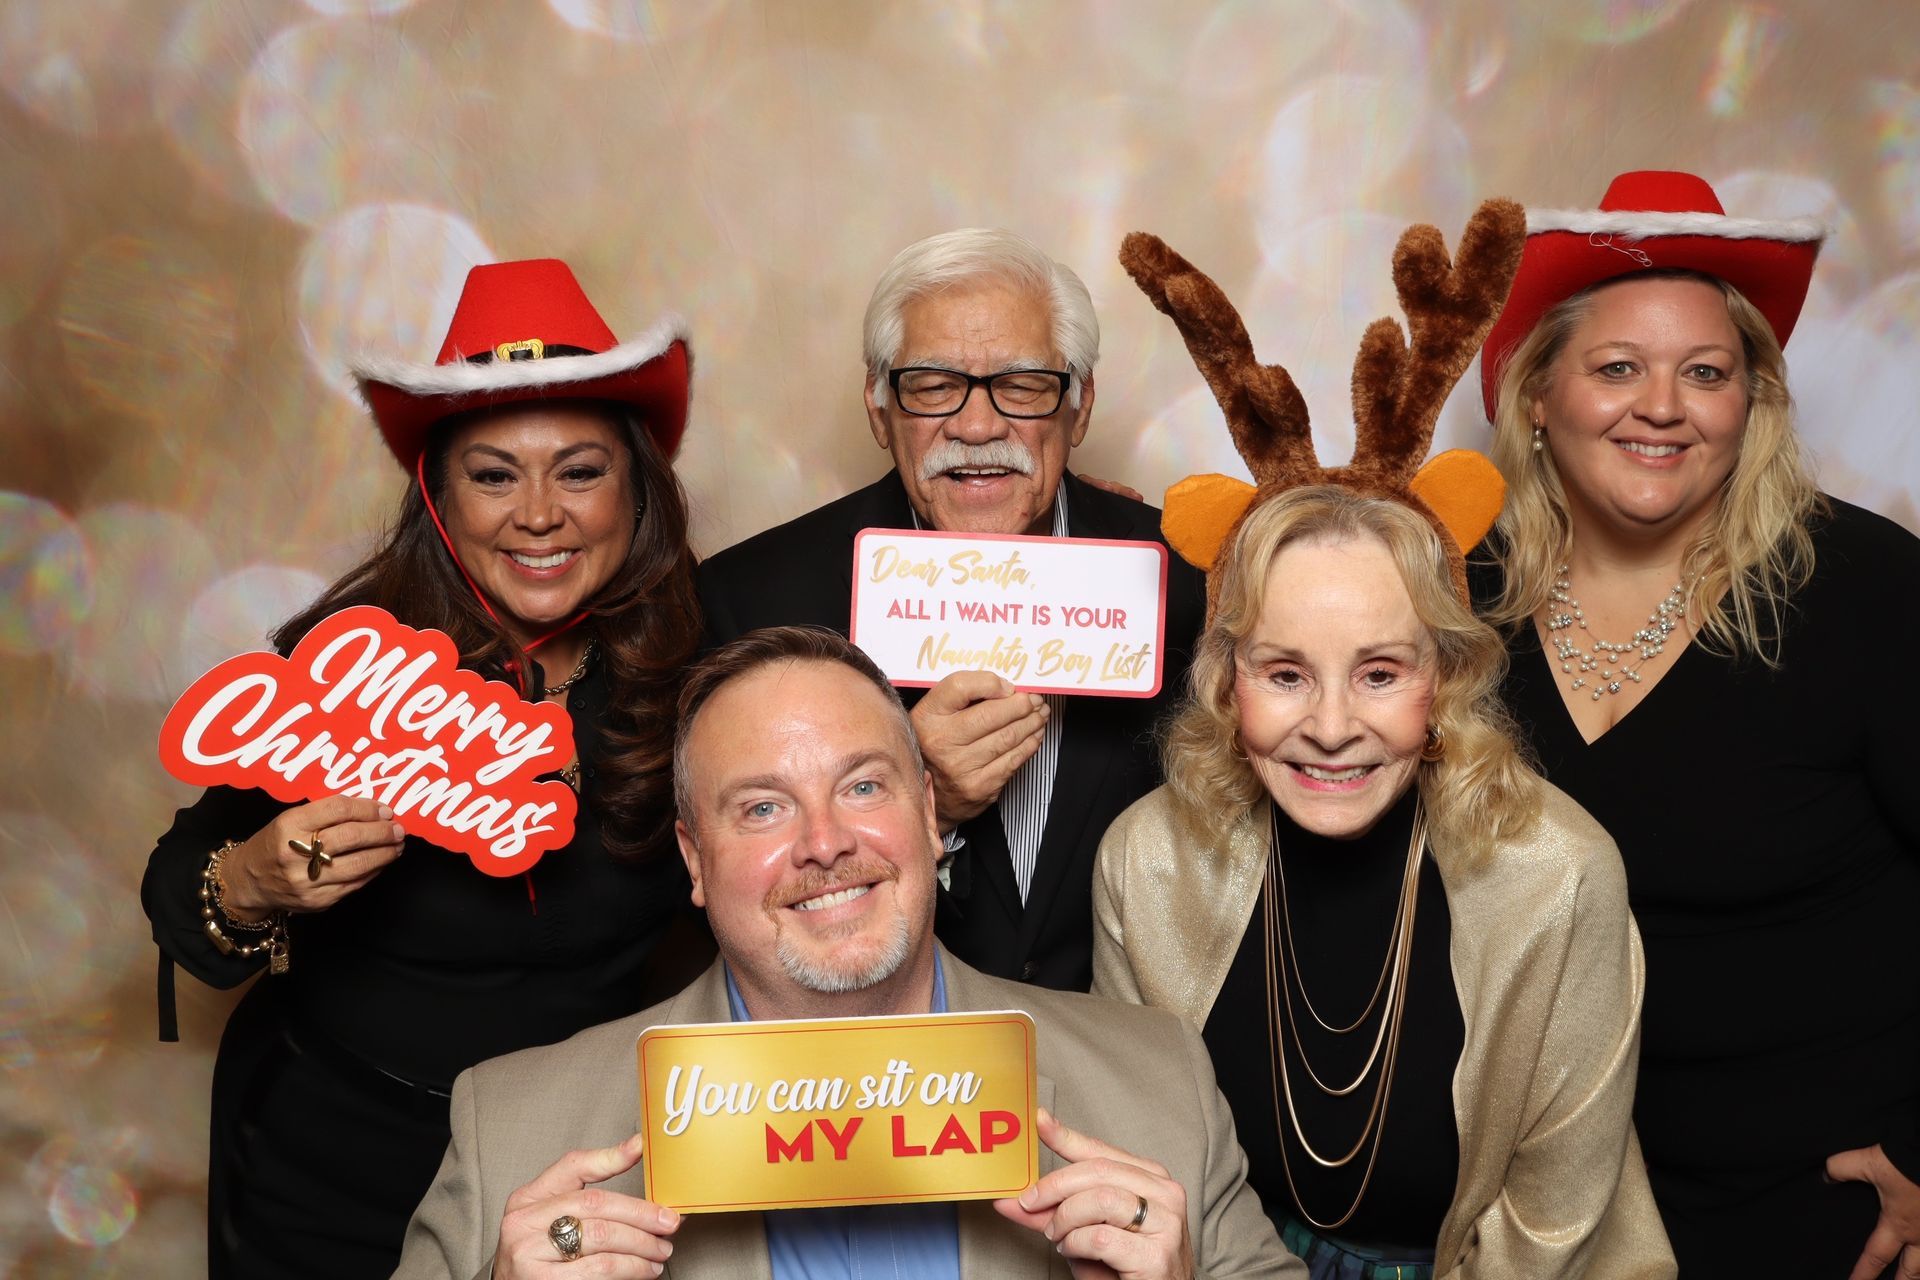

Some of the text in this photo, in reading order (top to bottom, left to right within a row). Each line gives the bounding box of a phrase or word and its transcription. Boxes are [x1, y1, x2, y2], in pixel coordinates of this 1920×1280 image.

[869, 545, 943, 588] Dear
[886, 599, 1127, 630] ALL I WANT IS YOUR
[915, 632, 1152, 684] Naughty Boy List
[309, 626, 555, 786] Merry
[181, 673, 558, 858] Christmas
[663, 1059, 984, 1136] You can sit on
[765, 1110, 1021, 1163] MY LAP
